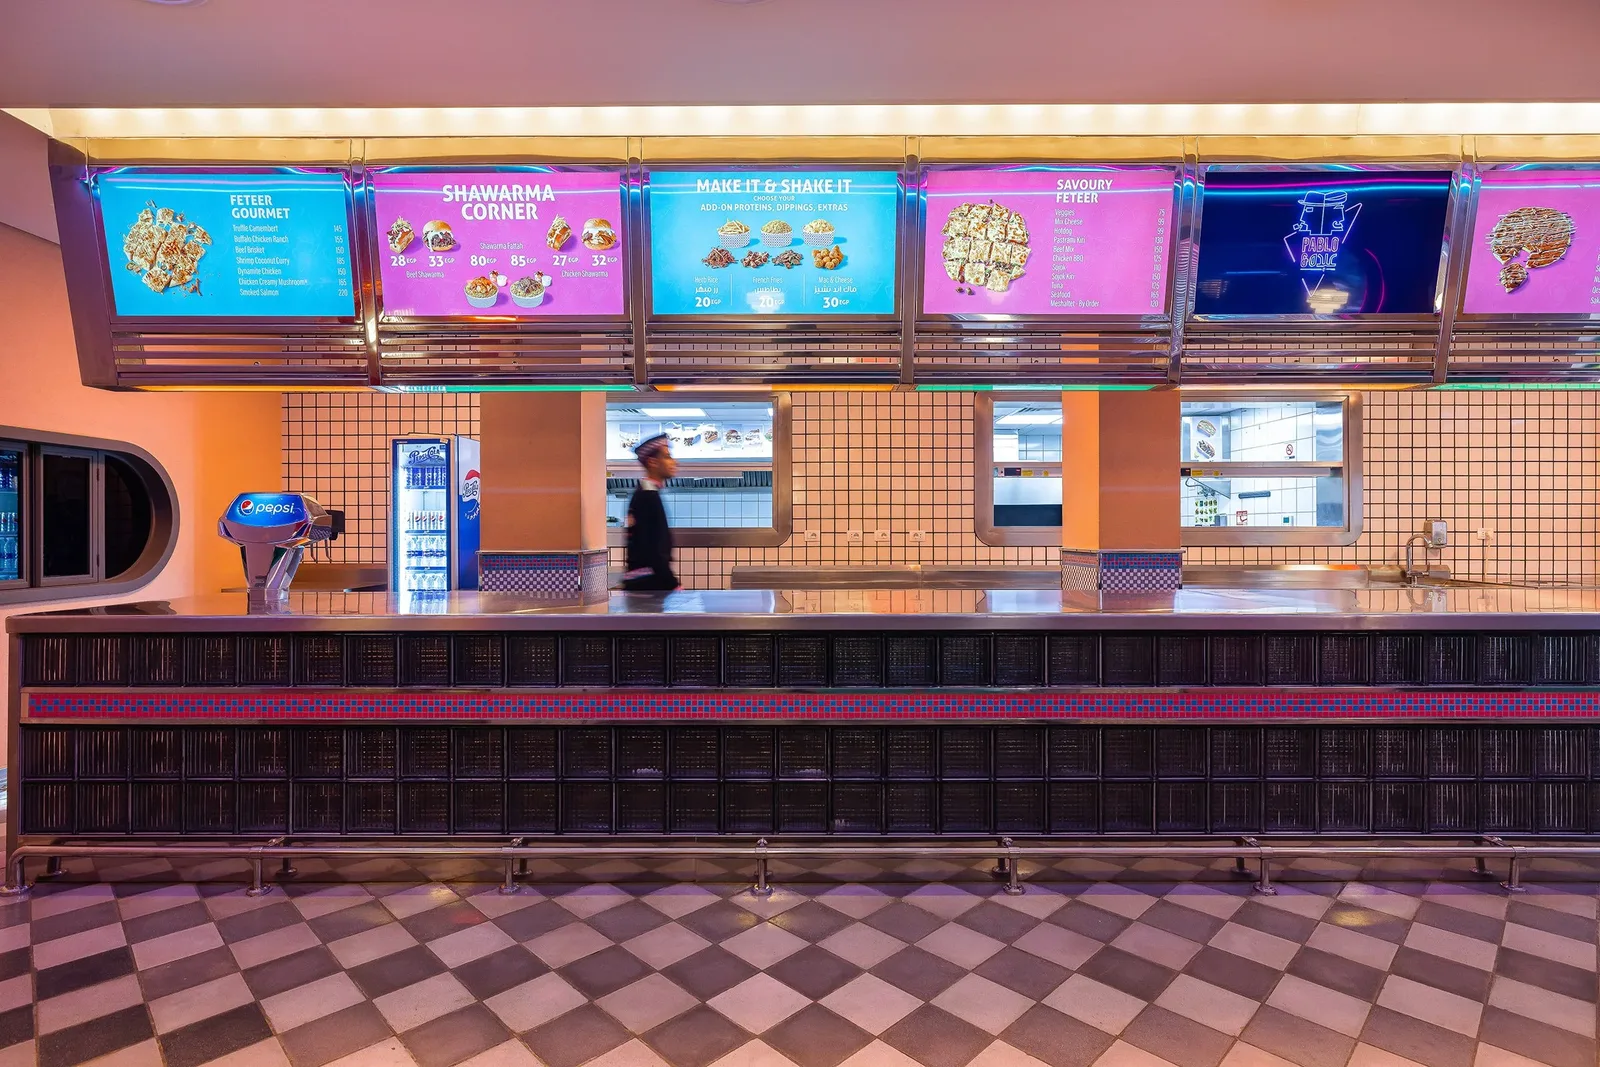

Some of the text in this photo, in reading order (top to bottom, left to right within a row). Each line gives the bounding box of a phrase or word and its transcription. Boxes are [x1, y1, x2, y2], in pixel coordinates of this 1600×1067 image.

[696, 179, 852, 193] MAKE IT & SHAKE IT
[1057, 179, 1113, 190] SAVOURY
[442, 184, 555, 202] SHAWARMA
[1056, 192, 1098, 203] FETEER
[230, 195, 273, 206] FETEER
[232, 208, 290, 219] GOURMET
[461, 203, 538, 220] CORNER
[734, 204, 774, 212] PROTEINS,
[777, 204, 816, 212] DIPPINGS,
[252, 235, 272, 243] Chicken
[273, 235, 289, 243] Ranch
[1302, 237, 1339, 252] PABLO
[391, 255, 406, 266] 28
[429, 255, 444, 266] 33
[470, 255, 486, 266] 80
[510, 255, 526, 266] 85
[553, 255, 567, 266] 27
[592, 255, 606, 266] 32
[695, 297, 711, 307] 20
[759, 297, 774, 308] 20
[823, 297, 839, 308] 30
[256, 503, 294, 515] pepsi
